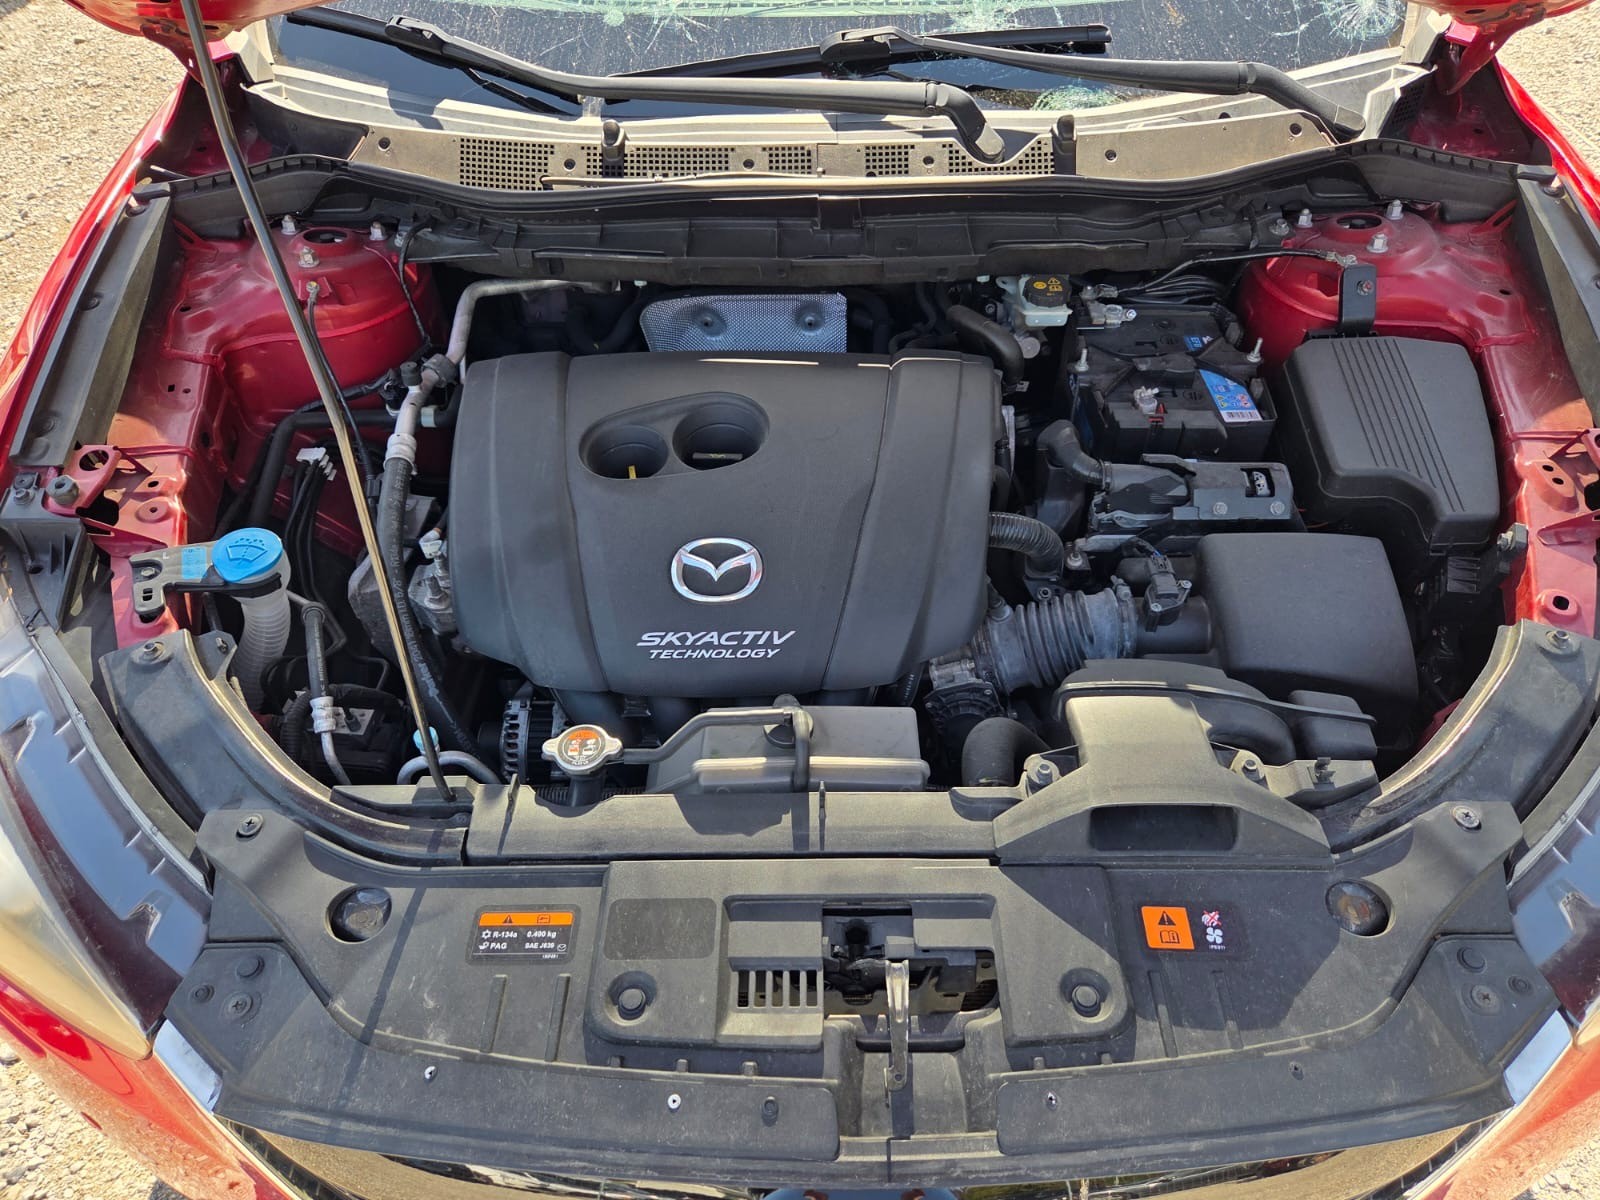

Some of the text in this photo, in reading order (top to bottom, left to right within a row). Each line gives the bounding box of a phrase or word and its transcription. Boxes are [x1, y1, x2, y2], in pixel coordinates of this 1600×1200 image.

[636, 630, 797, 647] SKYACTIV
[650, 648, 780, 659] TECHNOLOGY
[417, 662, 440, 697] Parker
[492, 930, 518, 938] R-134a
[547, 930, 557, 939] kg
[490, 942, 508, 950] PAG
